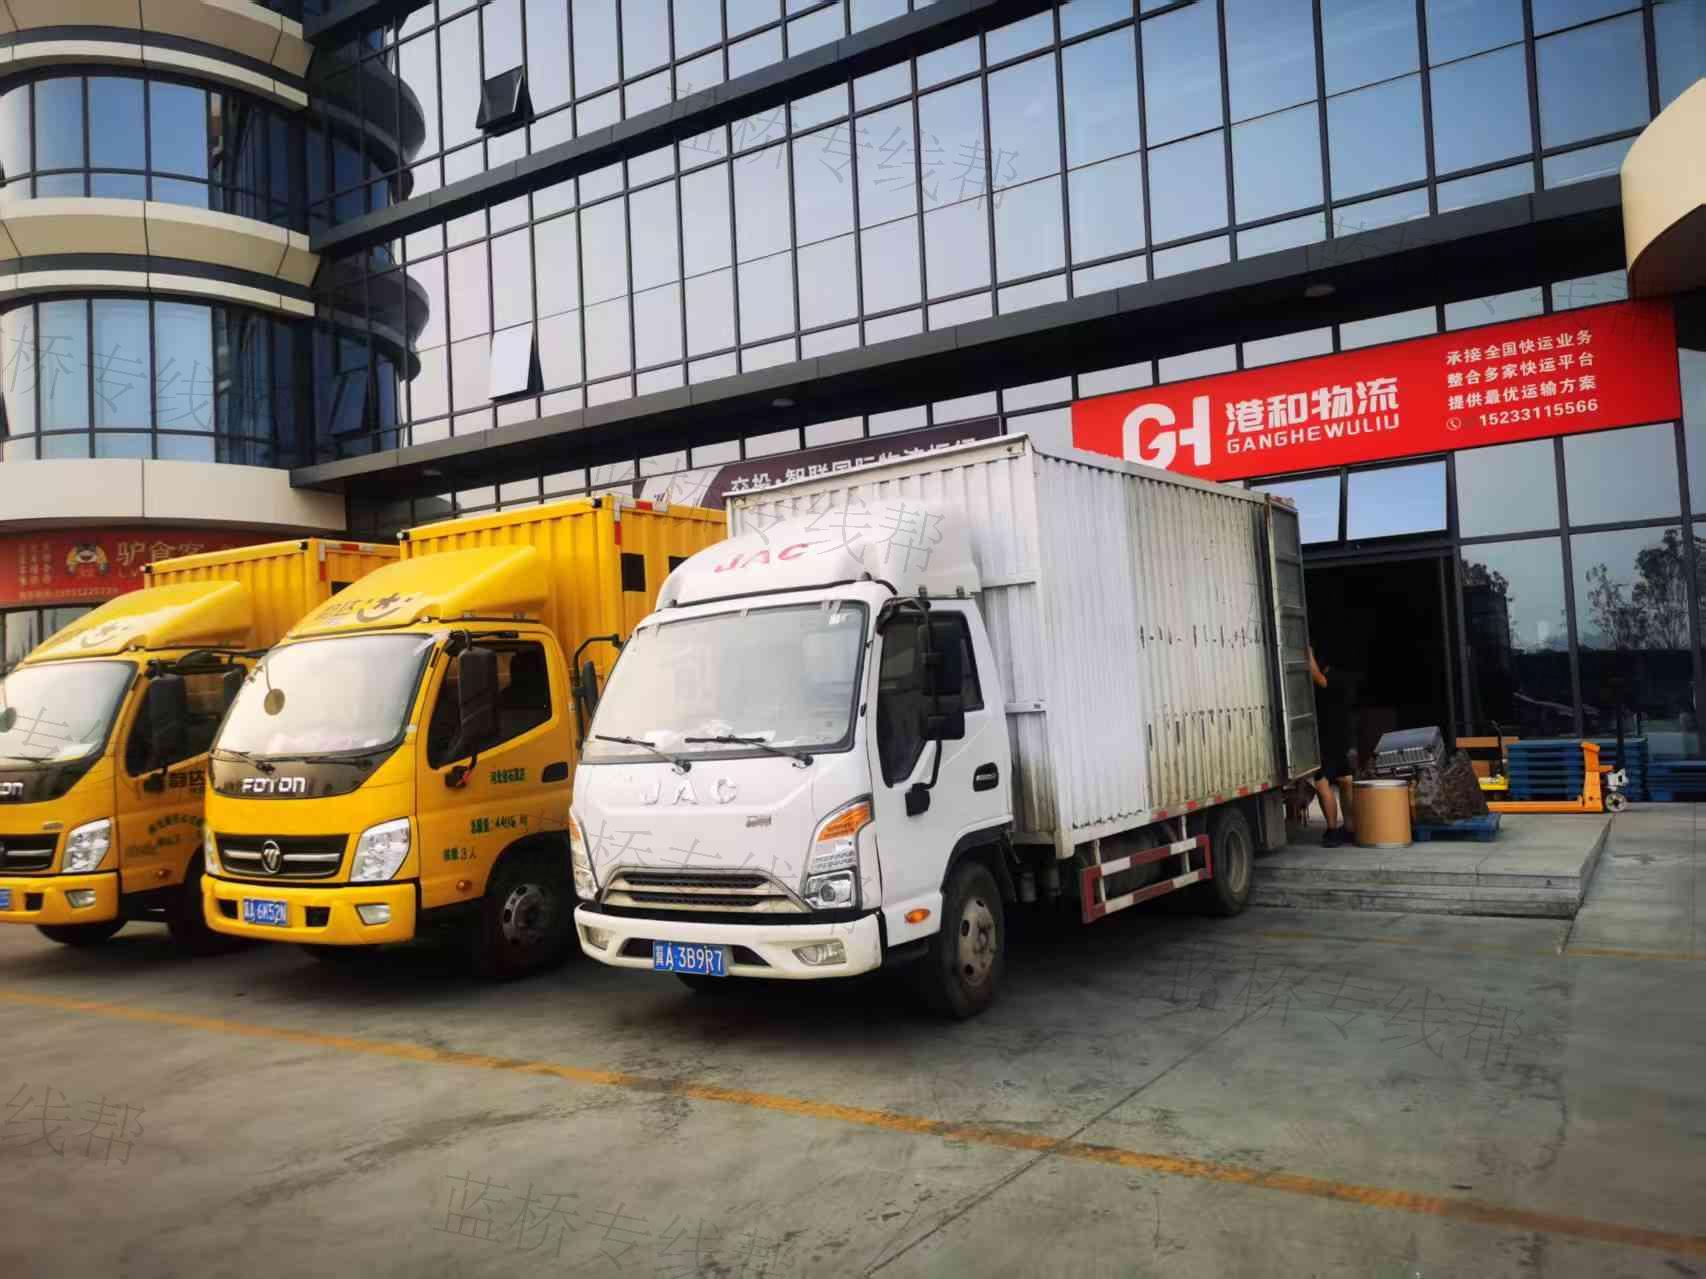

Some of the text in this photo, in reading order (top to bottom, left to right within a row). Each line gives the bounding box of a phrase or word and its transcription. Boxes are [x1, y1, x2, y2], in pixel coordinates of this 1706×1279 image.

[1446, 330, 1593, 366] 承接全国快运业务
[1447, 351, 1595, 389] 整合多家快运平台
[1225, 377, 1400, 436] 港和物流
[1448, 375, 1597, 411] 提供最优运输方案
[1479, 398, 1599, 427] 15233115566
[1226, 414, 1400, 454] GANGHEWULIU
[713, 543, 809, 573] JAC
[242, 776, 306, 793] FOTON
[641, 775, 737, 806] JAC
